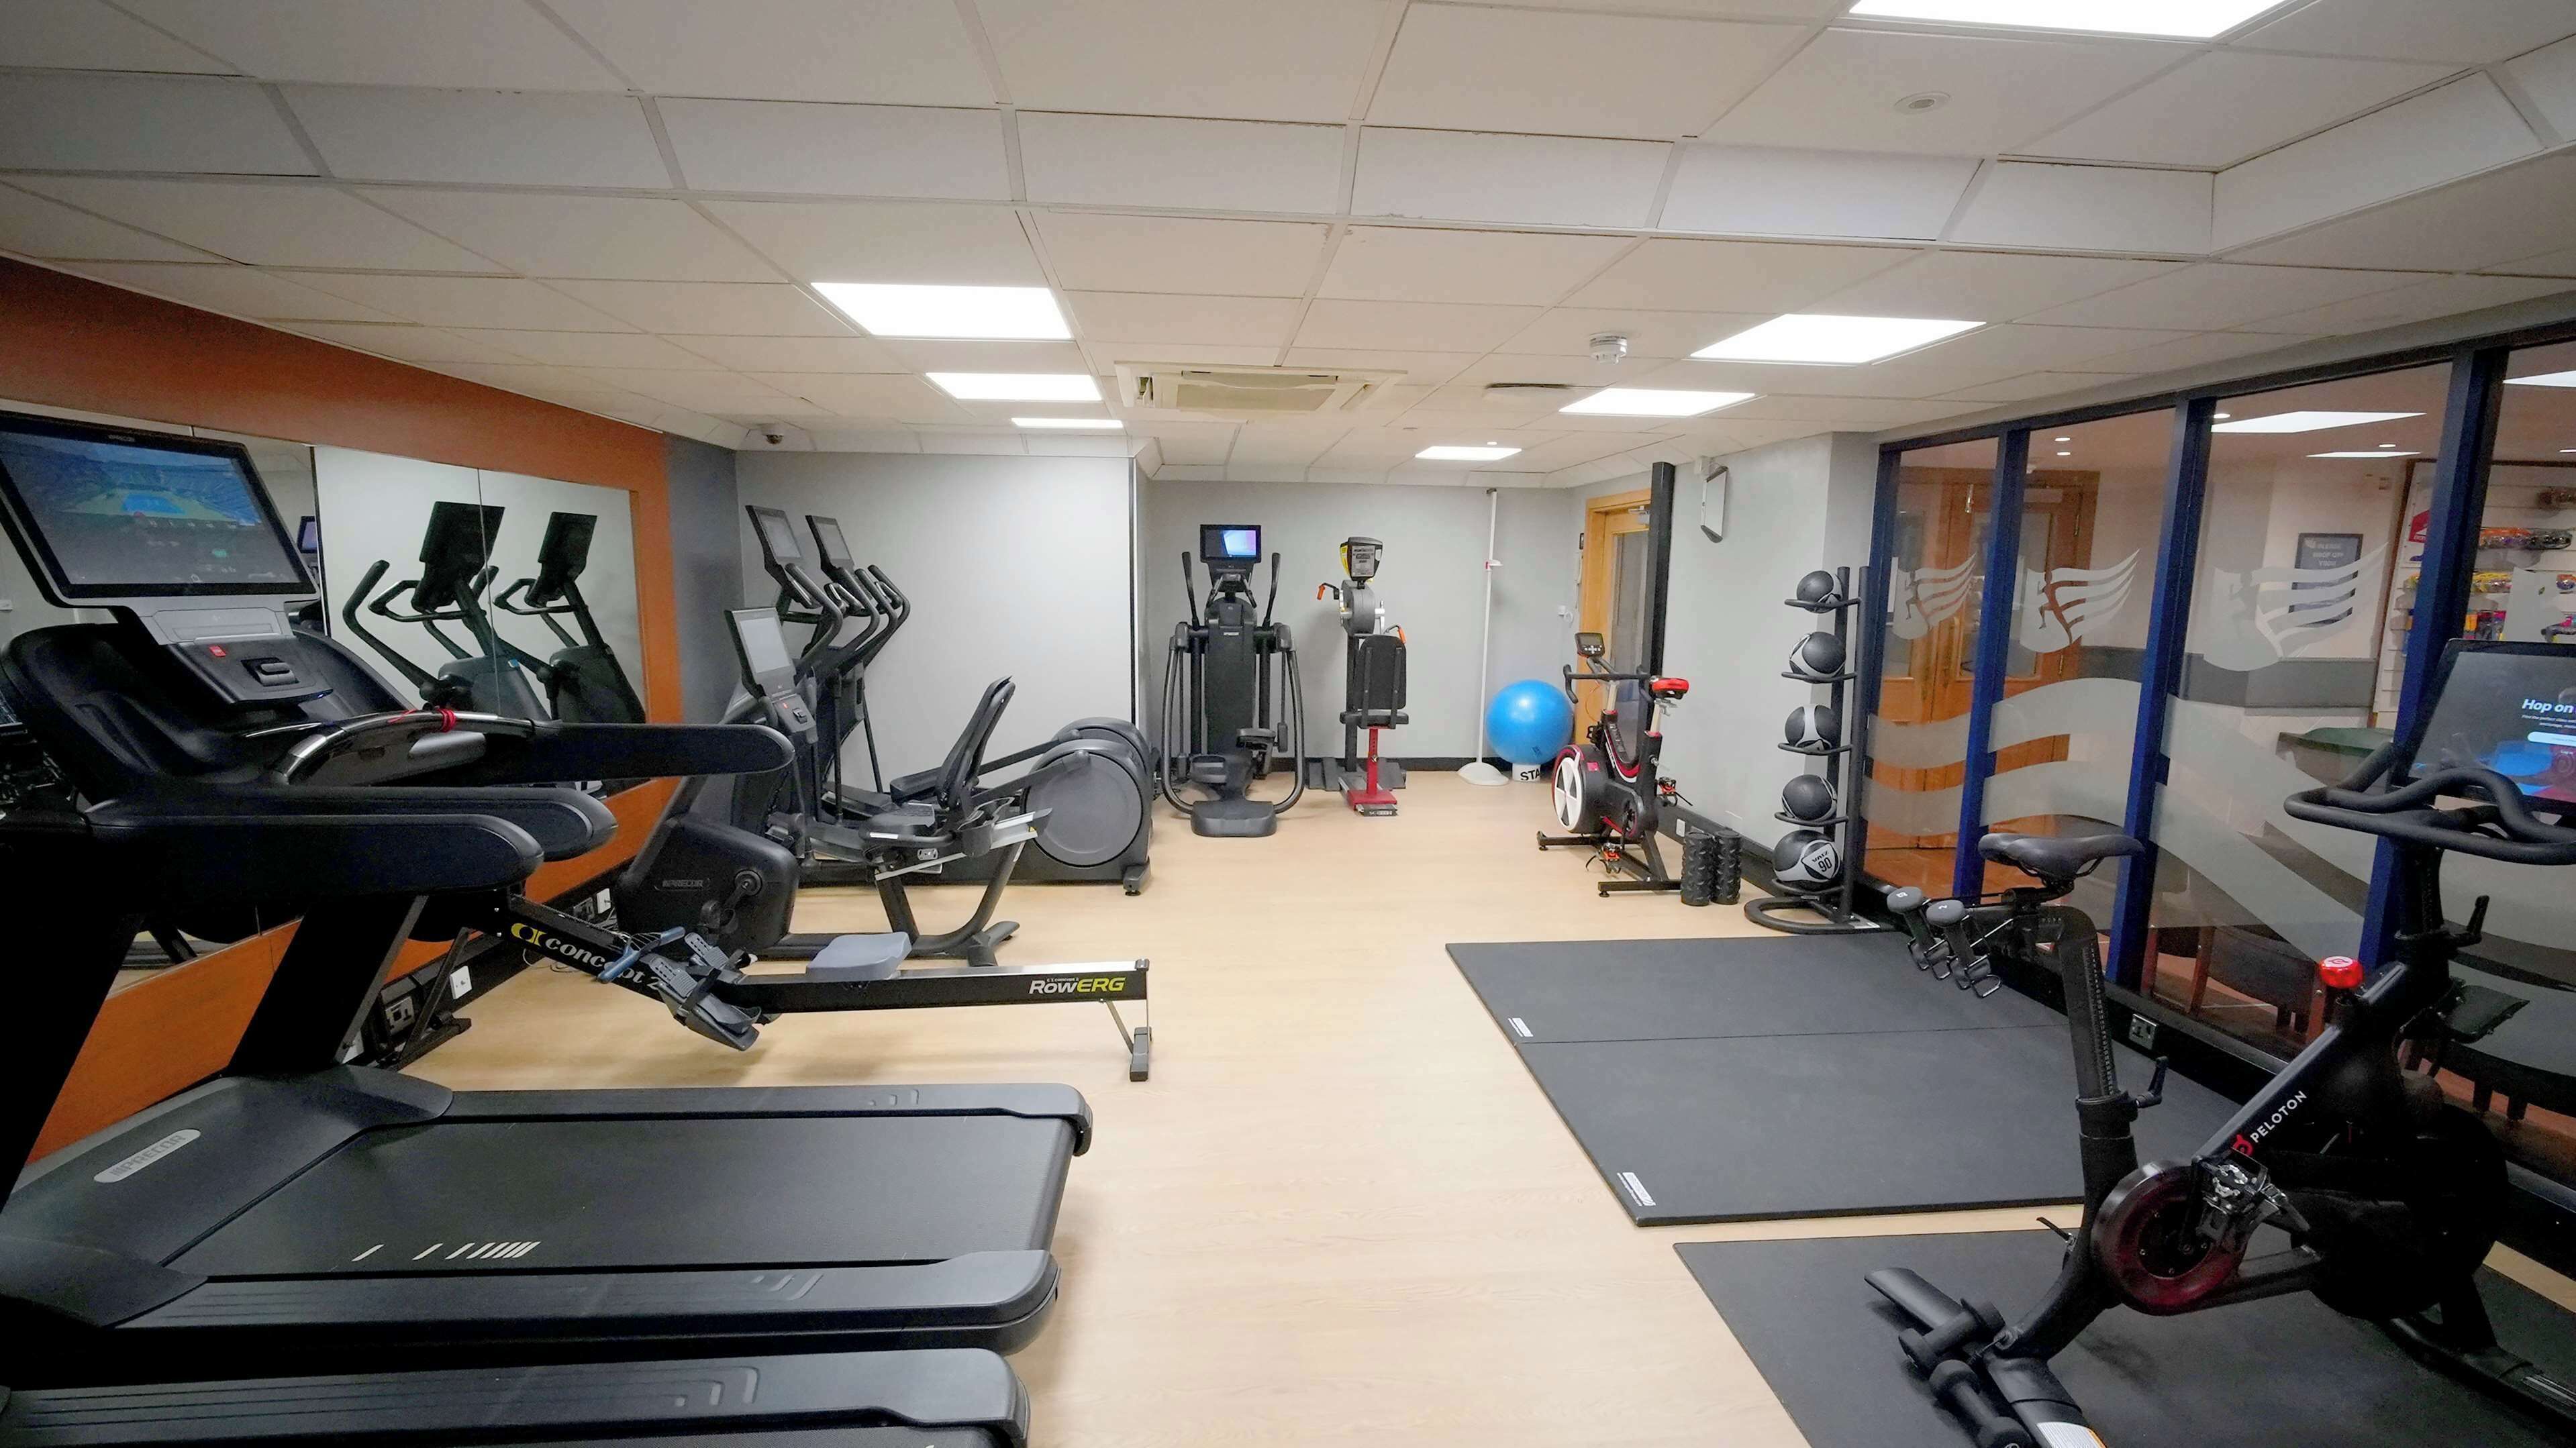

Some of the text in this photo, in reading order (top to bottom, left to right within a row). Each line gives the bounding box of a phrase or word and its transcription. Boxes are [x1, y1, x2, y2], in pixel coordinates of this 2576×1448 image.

[2522, 699, 2574, 713] Hop on
[2250, 1090, 2308, 1143] PELOTON
